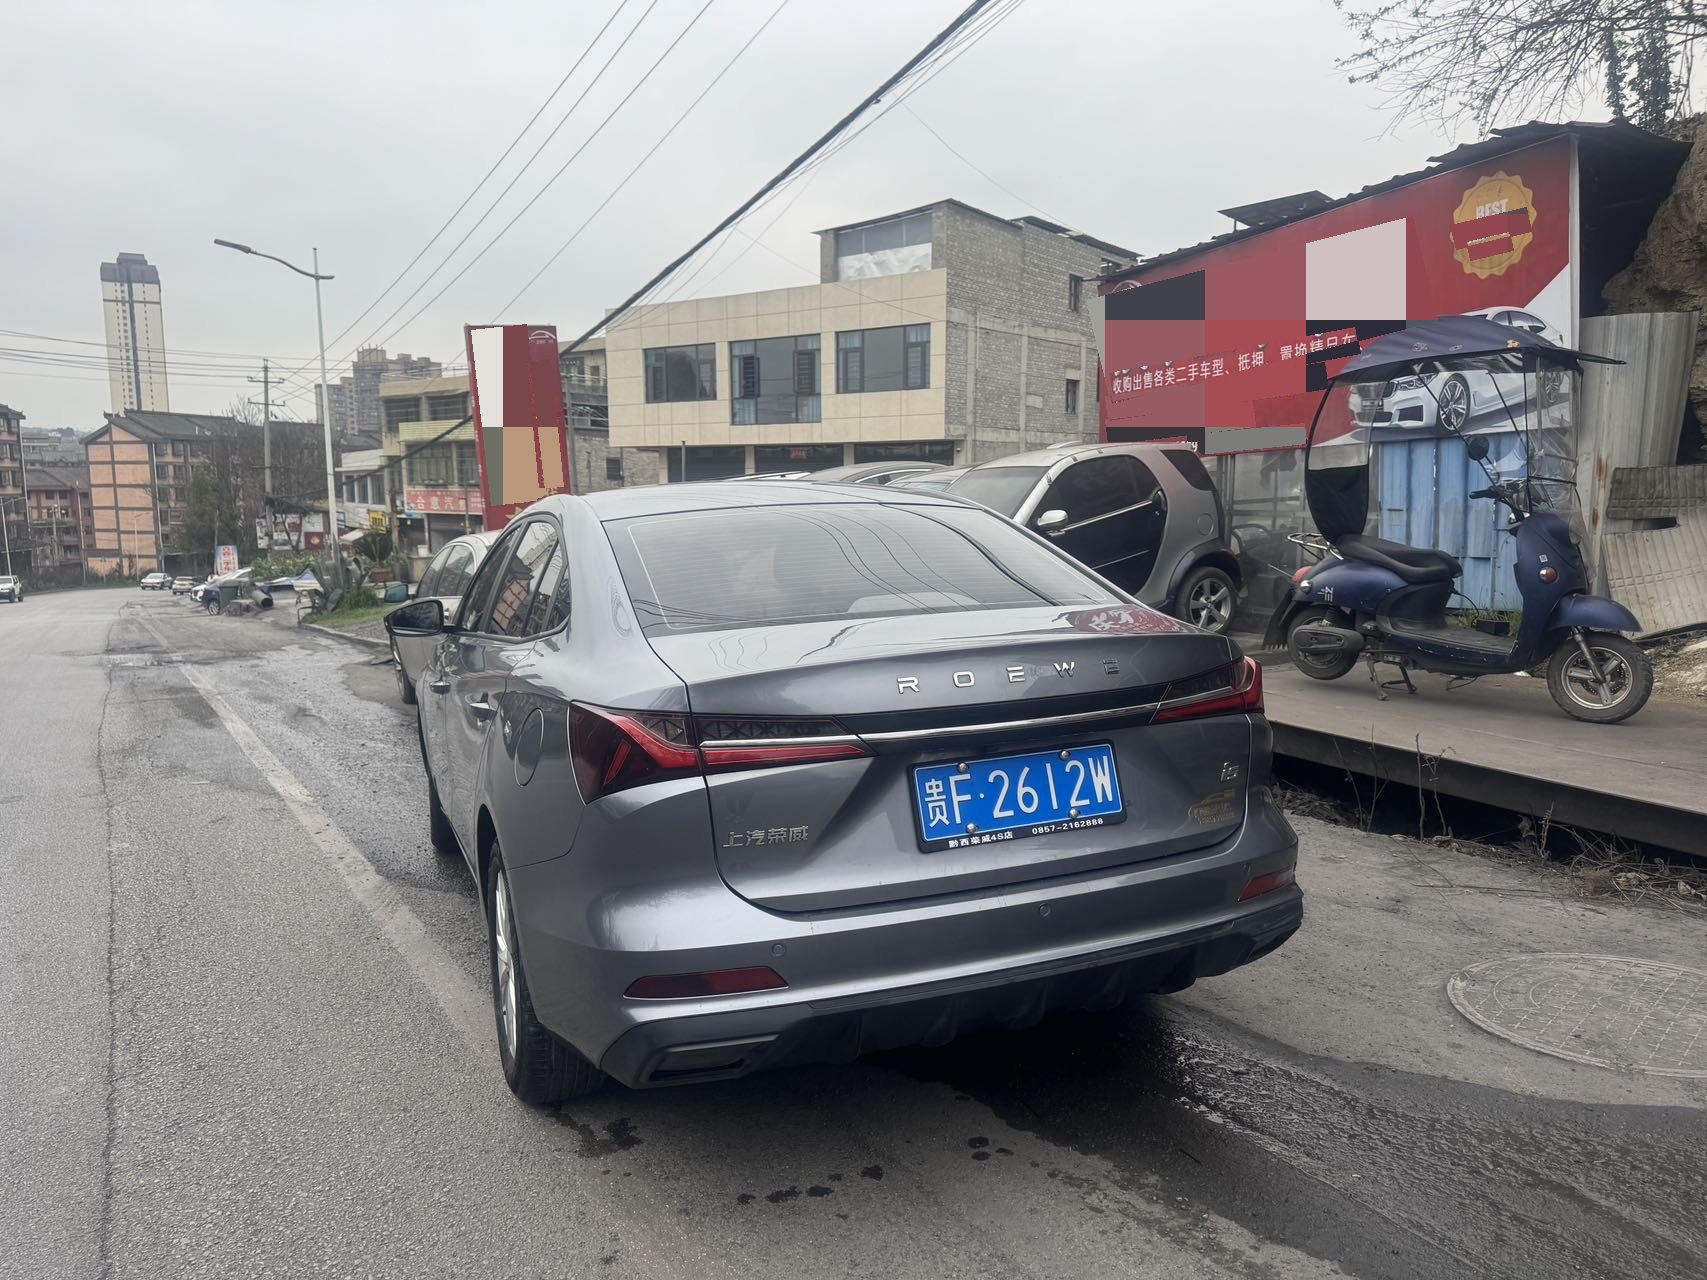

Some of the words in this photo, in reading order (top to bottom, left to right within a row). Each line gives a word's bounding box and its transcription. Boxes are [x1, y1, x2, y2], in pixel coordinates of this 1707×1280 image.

[896, 658, 1121, 694] ROEWE
[722, 825, 809, 848] 上汽荣威
[948, 831, 1014, 849] 黔西荣威4S店
[1032, 817, 1104, 835] 0857-2162888
